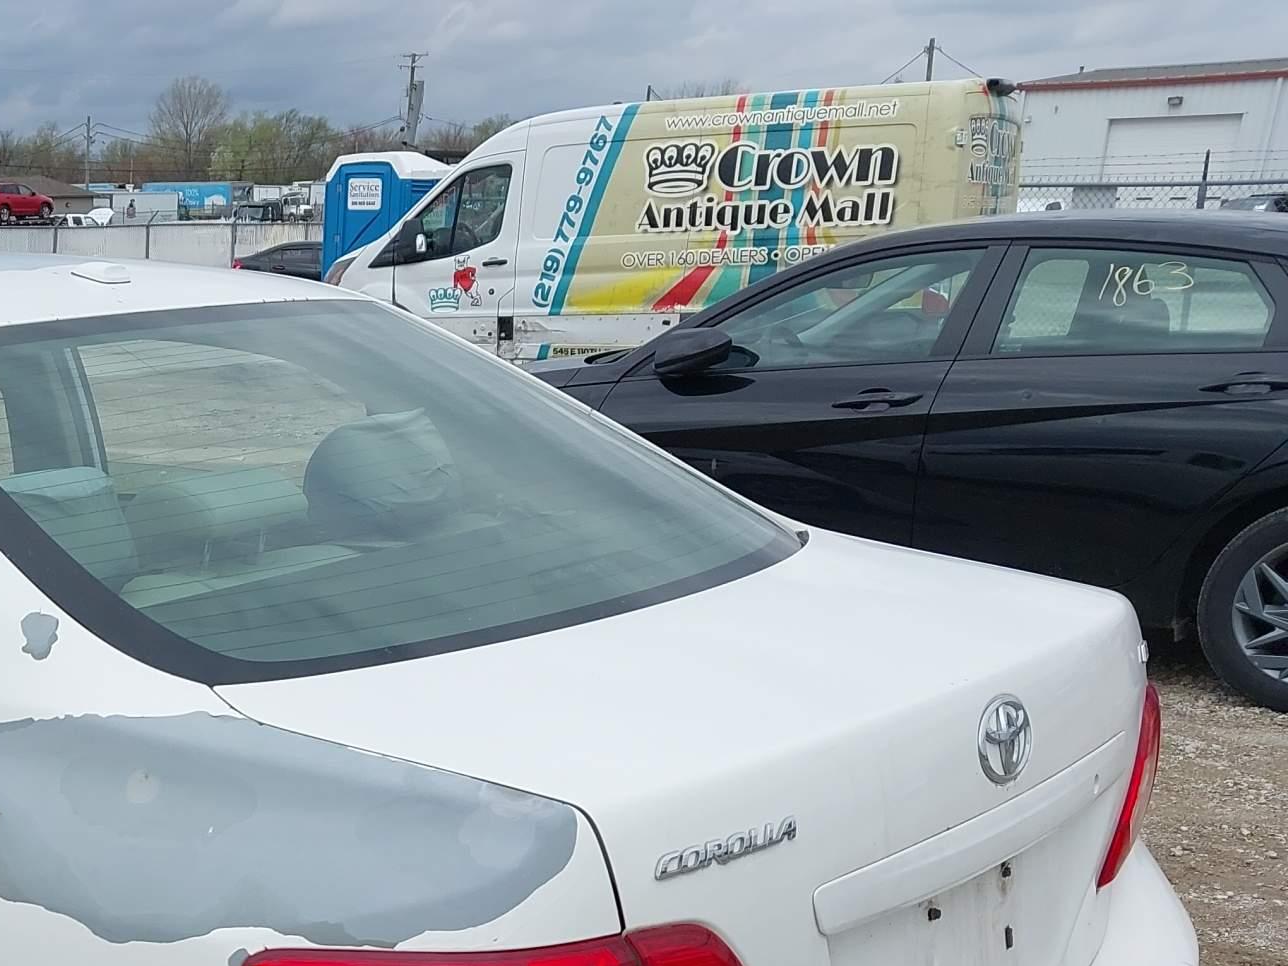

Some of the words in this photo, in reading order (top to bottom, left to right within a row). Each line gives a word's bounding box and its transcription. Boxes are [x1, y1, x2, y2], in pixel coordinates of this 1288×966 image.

[666, 101, 898, 131] www.crownantiquemall.net
[349, 181, 380, 192] Service
[717, 142, 898, 189] Crown
[532, 248, 565, 308] (219)
[553, 115, 613, 244] 779-9767
[637, 197, 792, 233] Antique
[798, 191, 895, 227] Mall
[621, 253, 664, 268] OVER
[669, 251, 696, 266] 160
[698, 248, 768, 266] DEALERS
[785, 246, 825, 262] OPE
[1098, 261, 1194, 306] 1863
[654, 815, 798, 881] COROLLA
